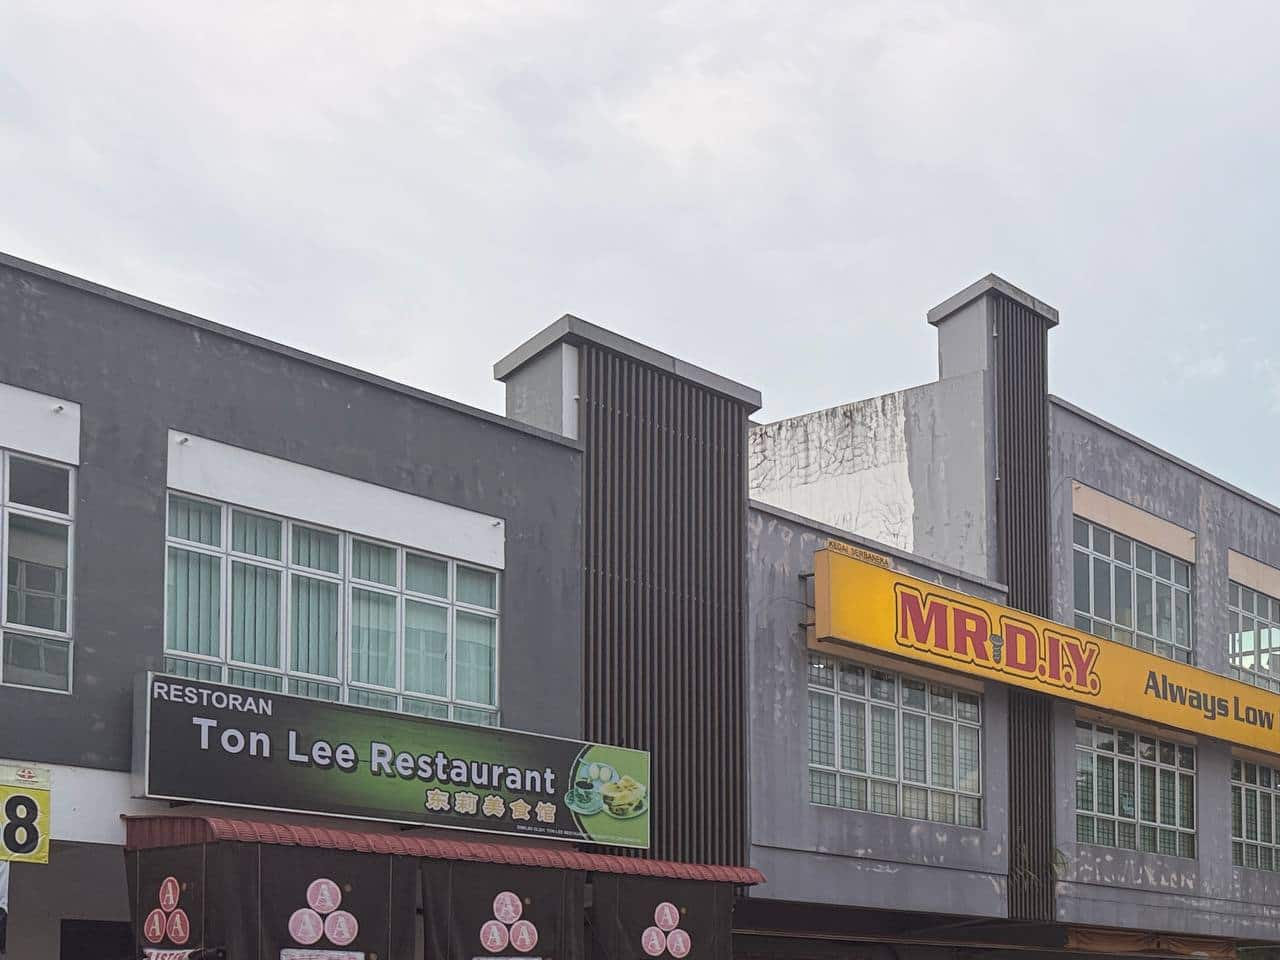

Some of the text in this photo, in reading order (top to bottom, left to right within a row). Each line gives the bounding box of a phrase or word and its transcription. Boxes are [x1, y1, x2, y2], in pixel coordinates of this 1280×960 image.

[153, 681, 273, 716] RESTORAN
[1143, 670, 1229, 721] Always
[1234, 696, 1275, 730] Low
[192, 716, 556, 795] Ton Lee Restaurant
[425, 788, 557, 823] 东莉美食馆
